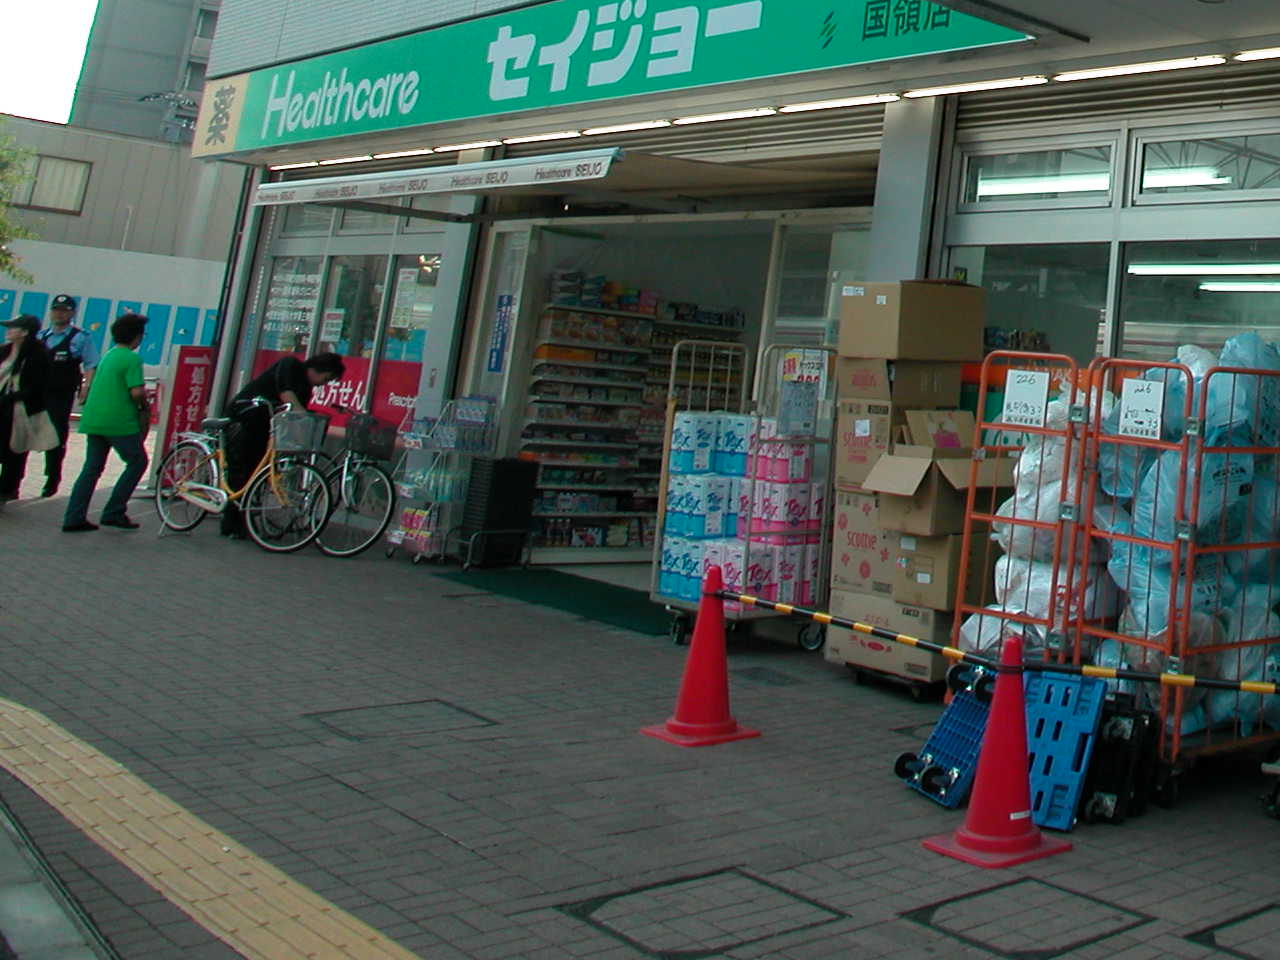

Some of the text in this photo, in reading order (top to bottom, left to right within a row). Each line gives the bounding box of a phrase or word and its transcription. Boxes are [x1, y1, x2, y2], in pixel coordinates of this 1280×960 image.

[205, 85, 237, 146] 薬
[261, 68, 421, 140] Healthcare
[534, 161, 602, 181] Healthcare SEIJO
